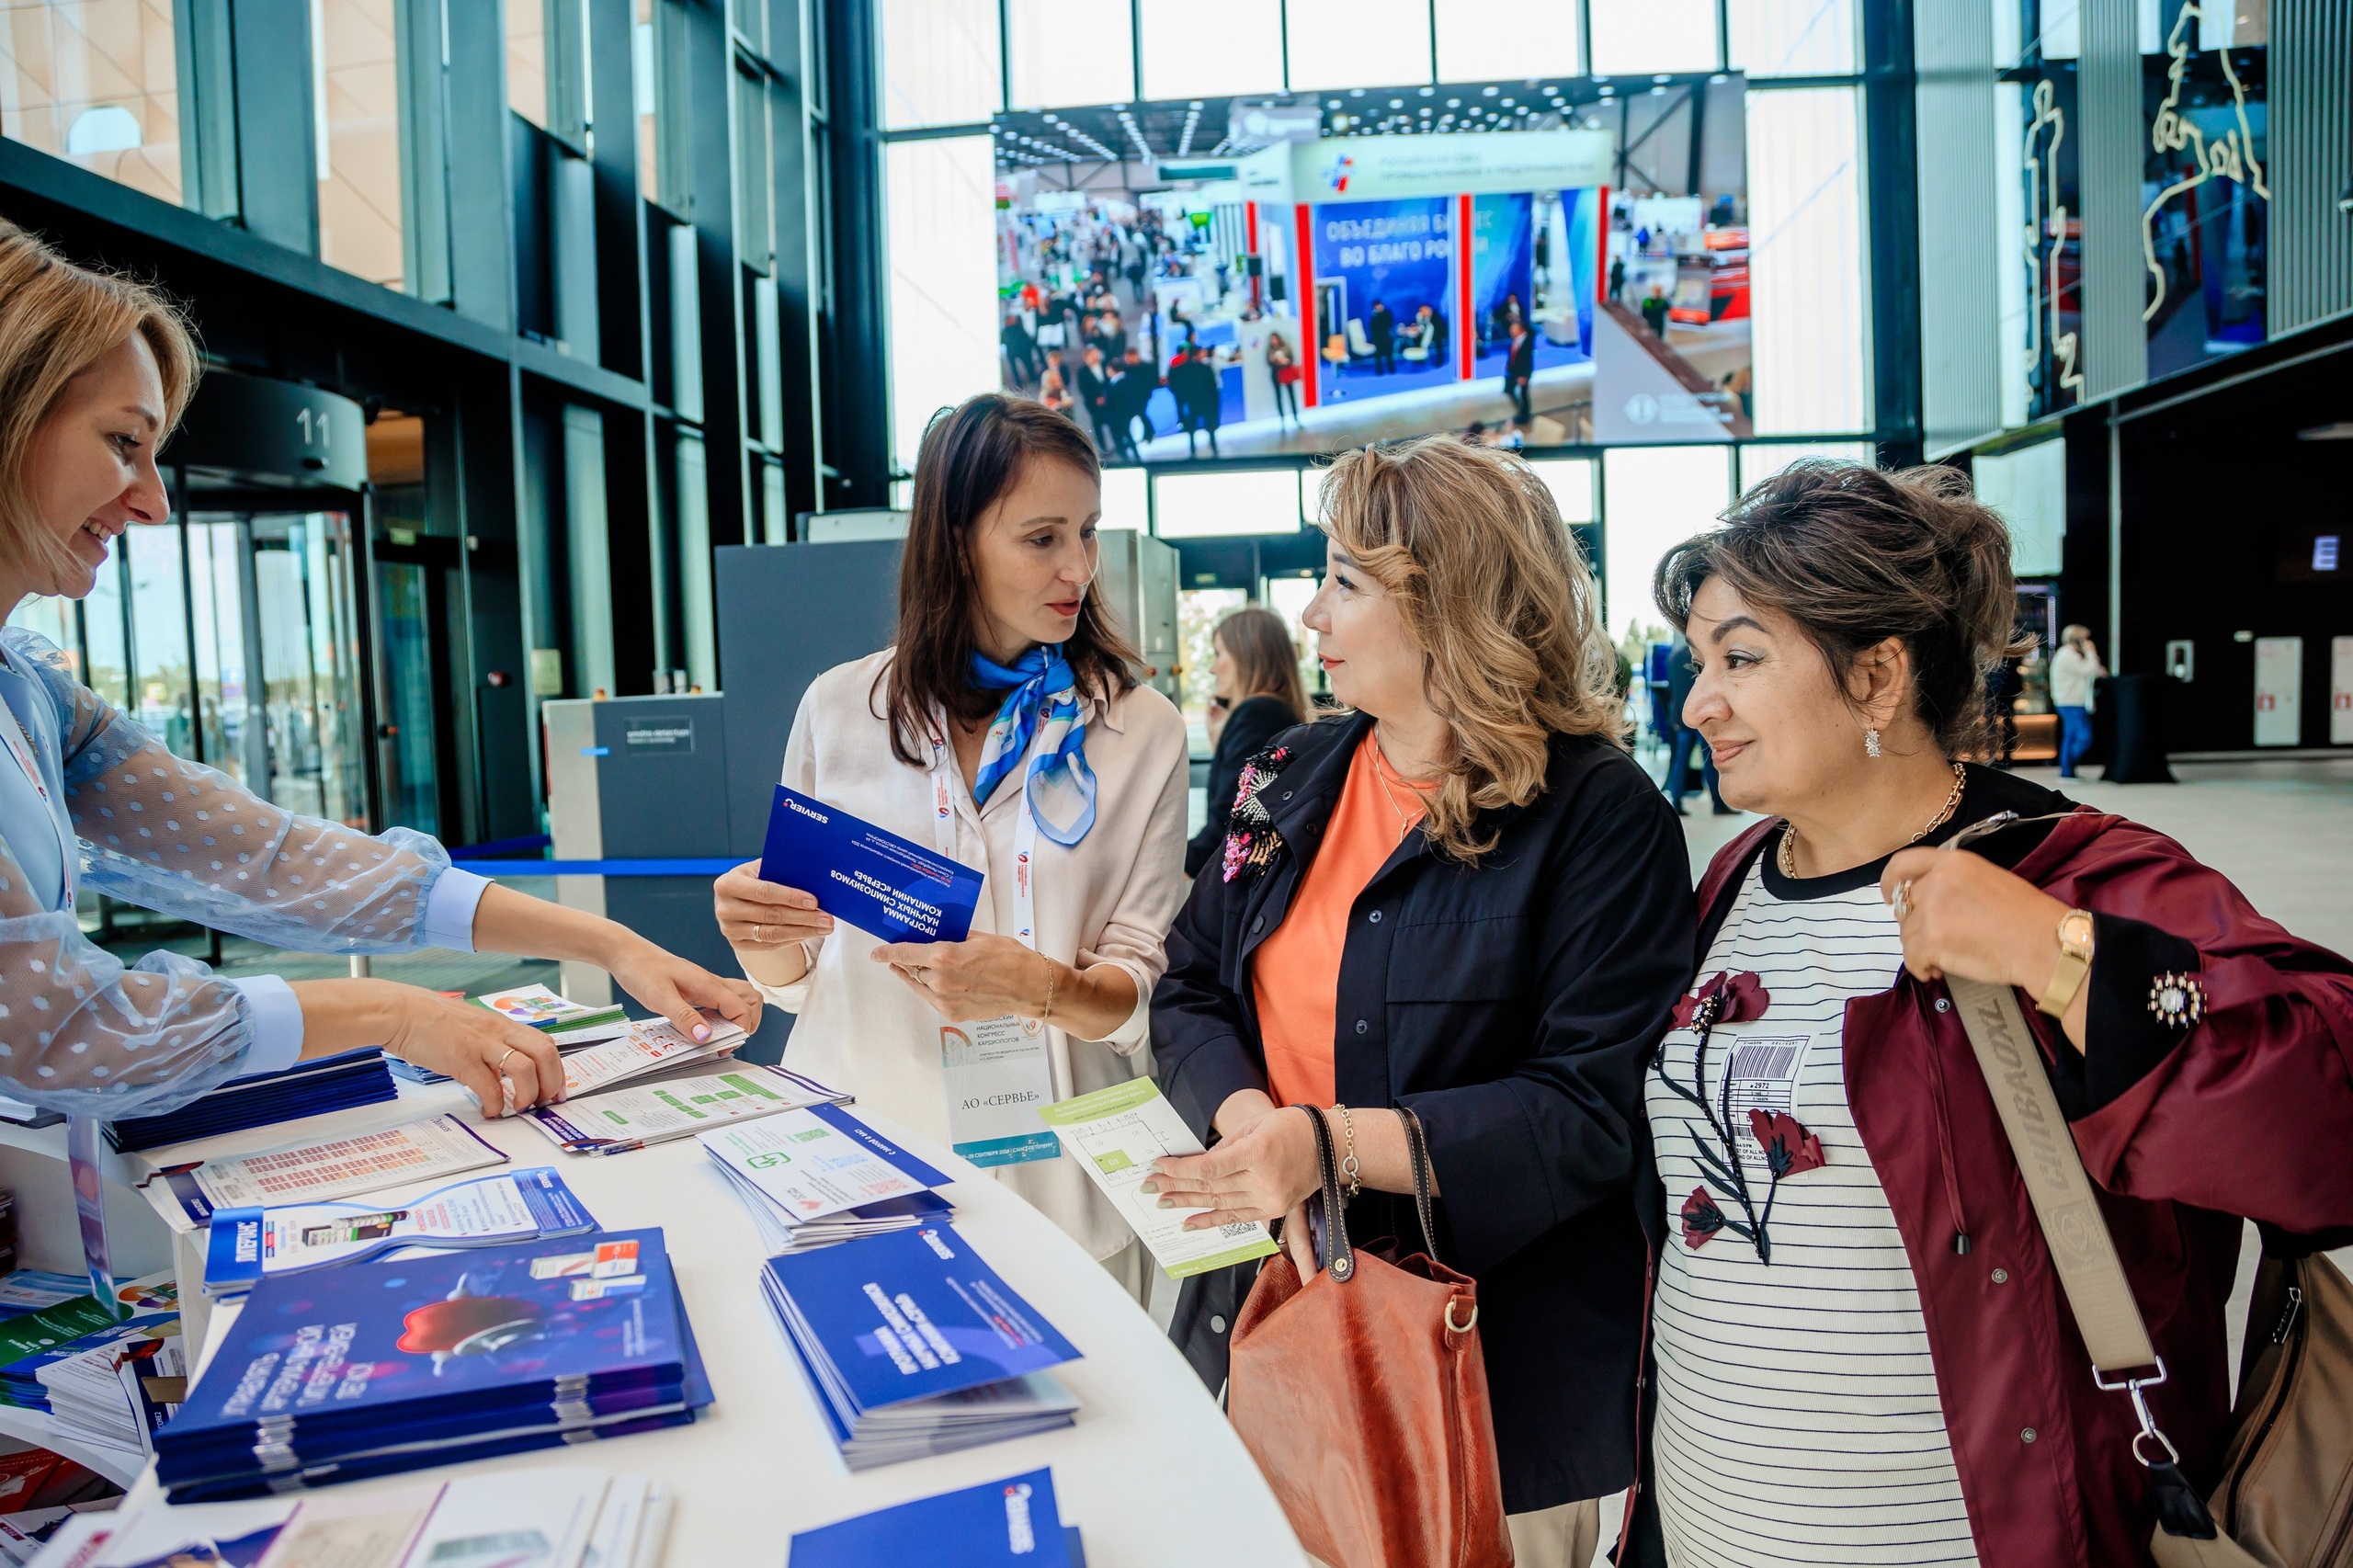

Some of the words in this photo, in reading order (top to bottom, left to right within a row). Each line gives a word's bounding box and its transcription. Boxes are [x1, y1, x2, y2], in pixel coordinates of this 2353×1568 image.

[296, 407, 331, 449] 11
[2312, 535, 2340, 571] E
[783, 796, 829, 824] SERVIER
[828, 868, 897, 907] СИМПОЗИУМОВ
[851, 869, 892, 894] «СЕРВЬЕ»
[891, 887, 943, 918] КОМПАНИИ
[896, 901, 940, 927] НАУЧНЫХ
[881, 903, 938, 937] ПРОГРАММА
[976, 1029, 1006, 1039] КОНГРЕСС
[977, 1036, 1019, 1047] КАРДИОЛОГОВ
[960, 1096, 980, 1109] АО
[982, 1088, 1040, 1108] «СЕРВЬЕ»
